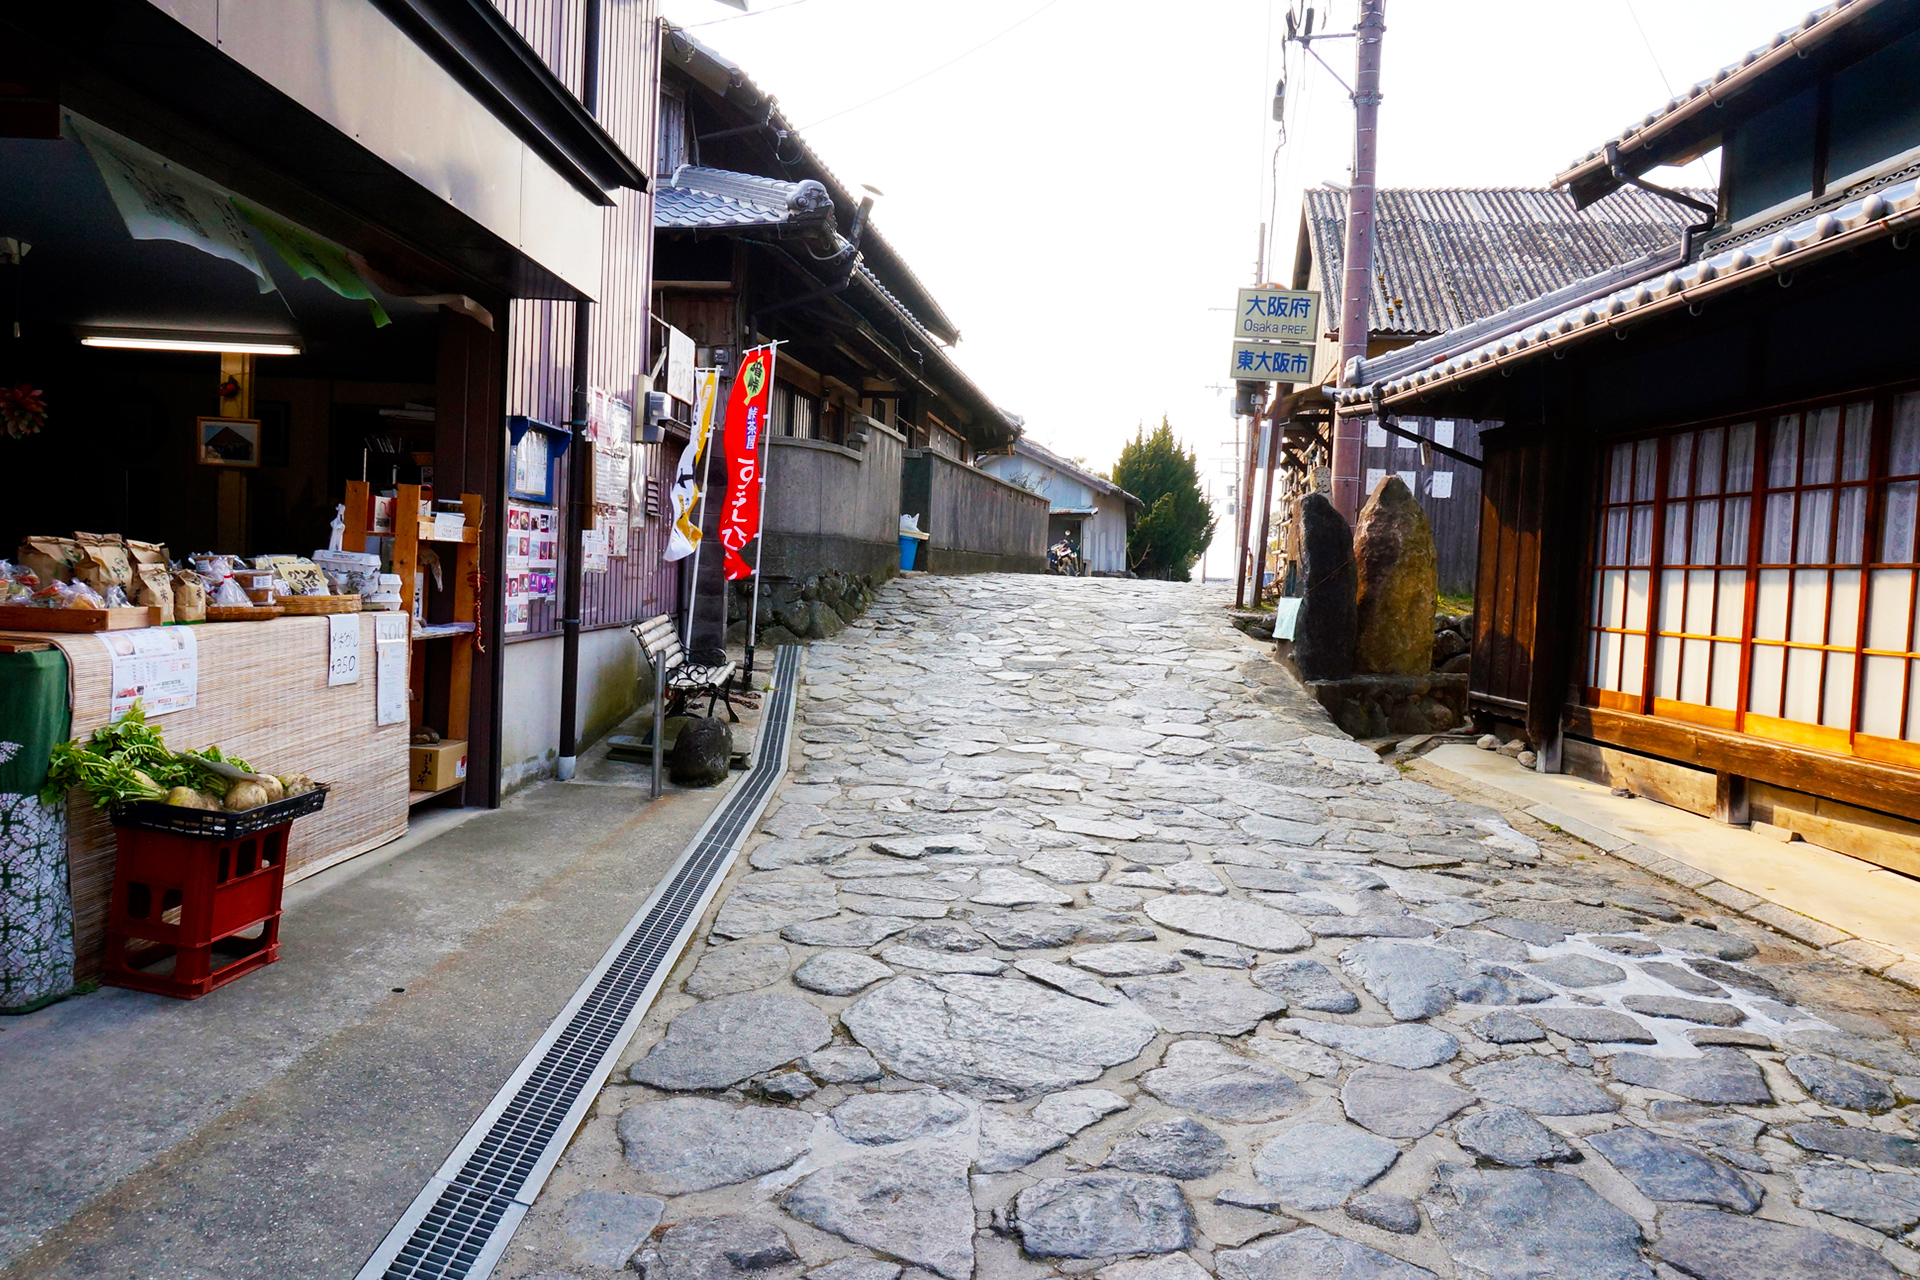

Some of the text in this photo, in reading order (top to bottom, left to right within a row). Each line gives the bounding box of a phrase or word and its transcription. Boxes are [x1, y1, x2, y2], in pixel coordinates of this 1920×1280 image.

[1245, 295, 1311, 318] 大阪府
[1244, 318, 1309, 335] Osaka PREF.
[1236, 350, 1308, 374] 東大阪市
